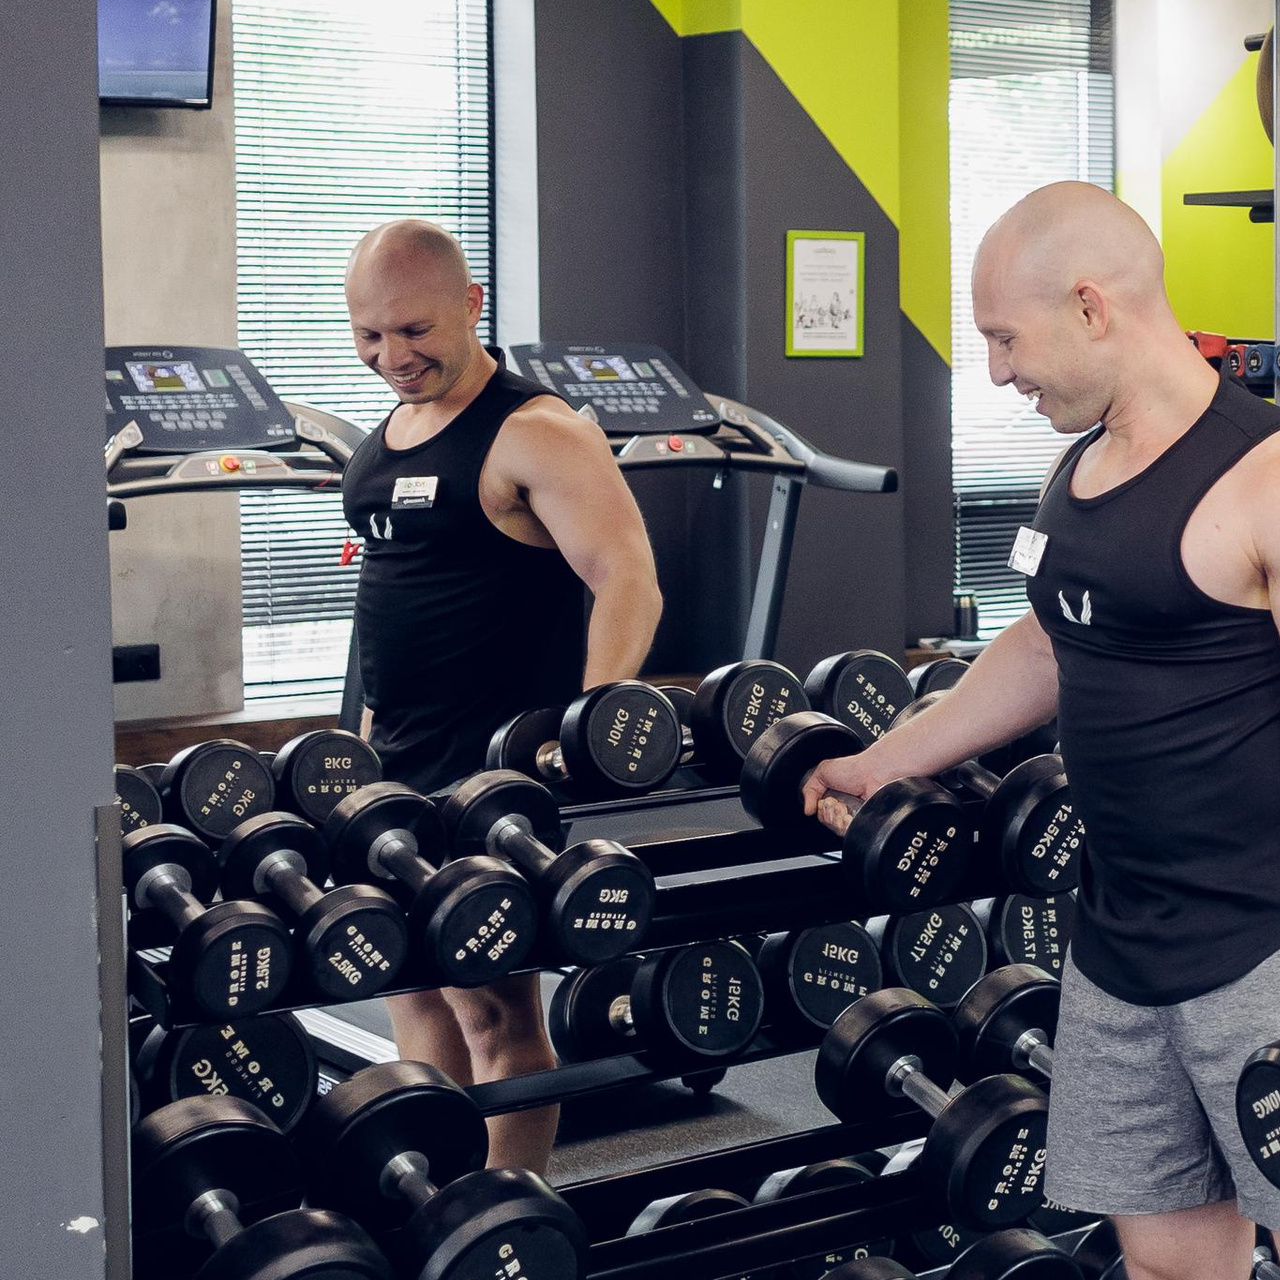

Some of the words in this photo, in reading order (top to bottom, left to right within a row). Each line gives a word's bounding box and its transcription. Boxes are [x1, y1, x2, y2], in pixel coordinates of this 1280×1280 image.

[897, 830, 928, 871] 10KG
[1031, 804, 1073, 859] 12.5KG
[1048, 821, 1086, 880] ROME
[909, 826, 956, 898] GROME
[599, 889, 629, 903] 5KG
[455, 898, 512, 960] GROME
[487, 929, 517, 961] 5KG
[573, 918, 637, 931] GROME
[256, 947, 271, 990] 2.5KG
[328, 952, 363, 985] 2.5KG
[346, 925, 390, 971] GROME
[228, 941, 242, 1006] GROME
[987, 1128, 1030, 1210] GROME
[1021, 1148, 1047, 1195] 15KG
